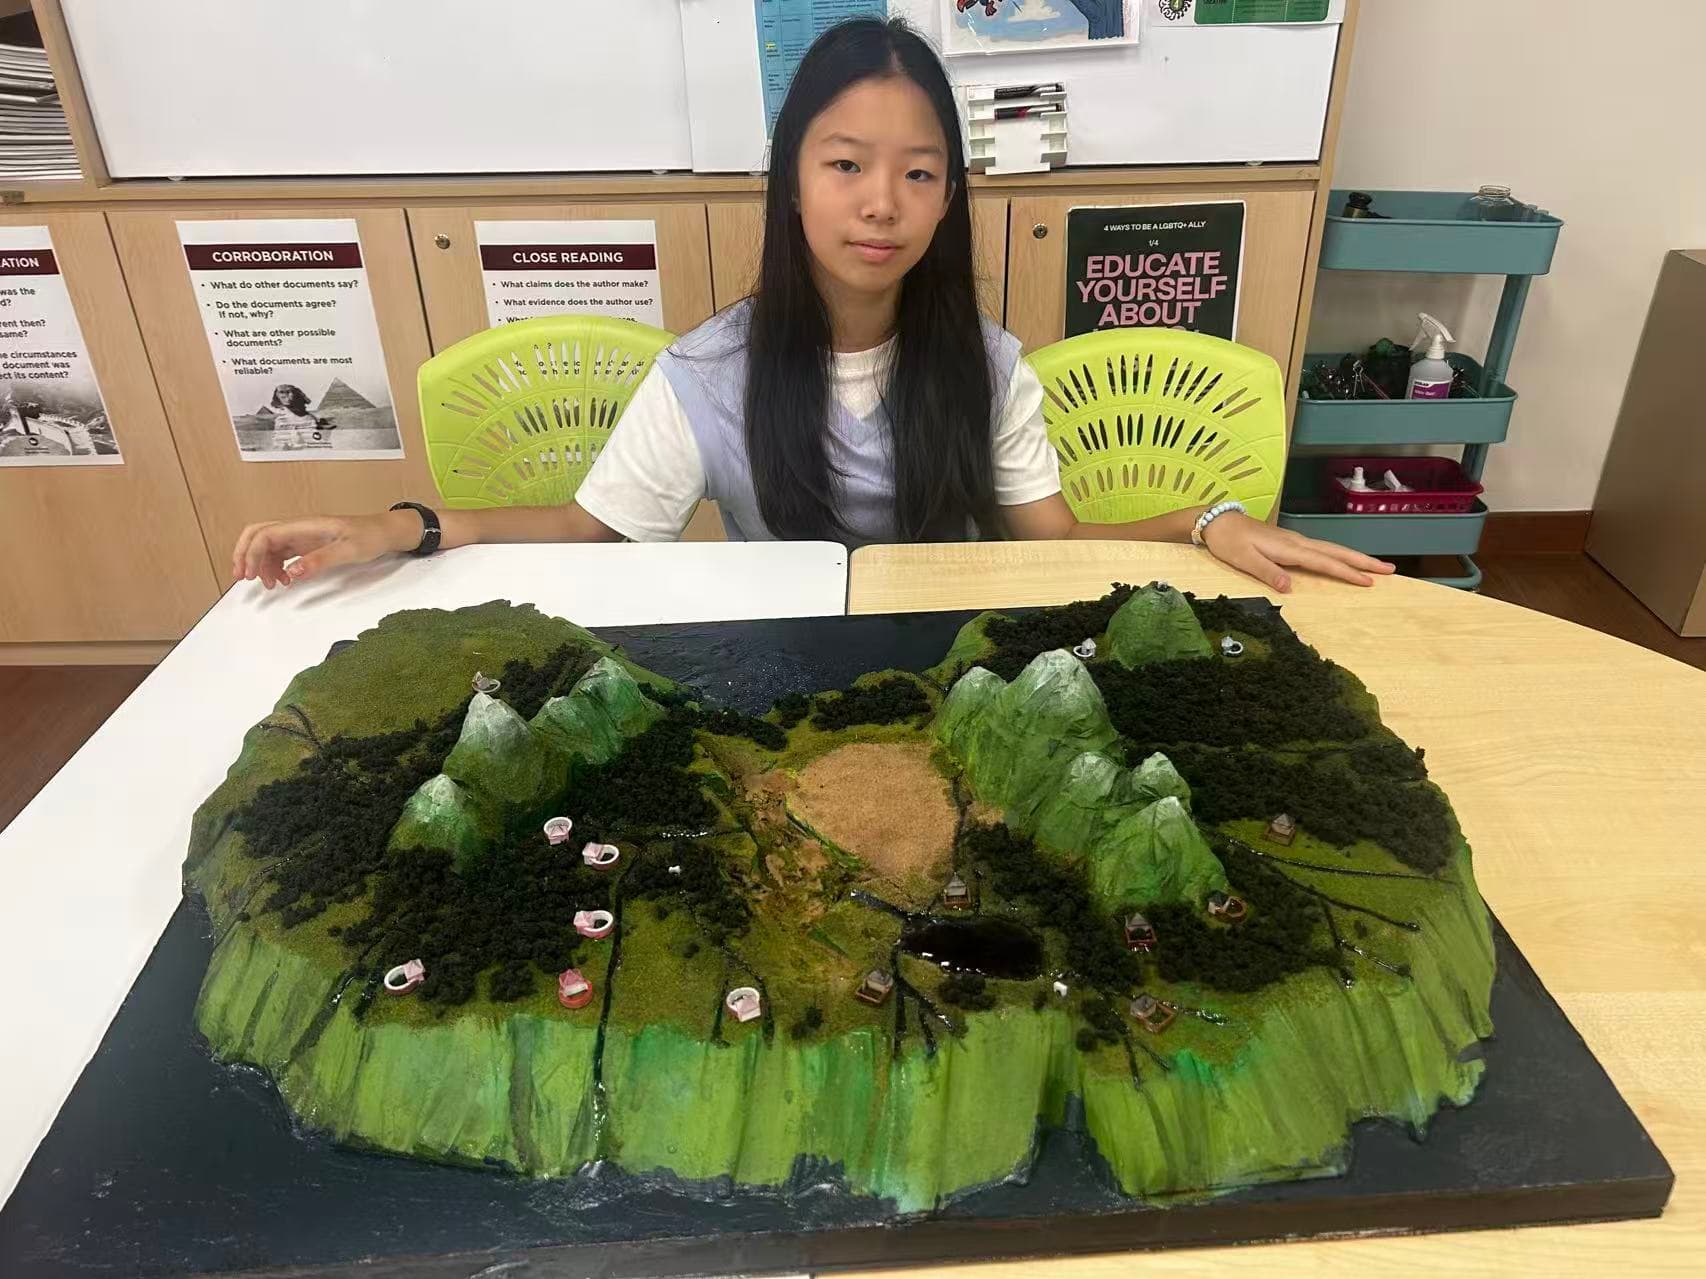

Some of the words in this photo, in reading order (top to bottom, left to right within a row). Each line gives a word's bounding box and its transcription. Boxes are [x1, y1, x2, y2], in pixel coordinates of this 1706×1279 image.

[212, 250, 334, 262] CORROBORATION
[512, 252, 558, 263] CLOSE
[562, 252, 624, 263] READING
[0, 257, 40, 268] ATION
[1086, 252, 1220, 278] EDUCATE
[210, 282, 237, 290] What
[239, 281, 252, 289] do
[282, 280, 336, 288] documents
[337, 280, 359, 289] say?
[1076, 276, 1228, 303] YOURSELF
[216, 301, 230, 309] Do
[232, 300, 248, 309] the
[250, 300, 303, 308] documents
[305, 300, 336, 310] agree?
[504, 298, 526, 306] What
[528, 298, 566, 306] evidence
[568, 298, 588, 306] does
[590, 298, 604, 306] the
[606, 298, 632, 306] author
[634, 298, 653, 306] use?
[219, 311, 226, 319] If
[228, 311, 248, 320] not,
[250, 310, 274, 320] why?
[1098, 302, 1201, 326] ABOUT
[20, 319, 46, 327] then?
[223, 330, 250, 338] What
[270, 330, 294, 338] other
[297, 329, 336, 338] possible
[226, 338, 282, 348] documents?
[259, 357, 310, 366] documents
[330, 356, 352, 364] most
[234, 366, 273, 375] reliable?
